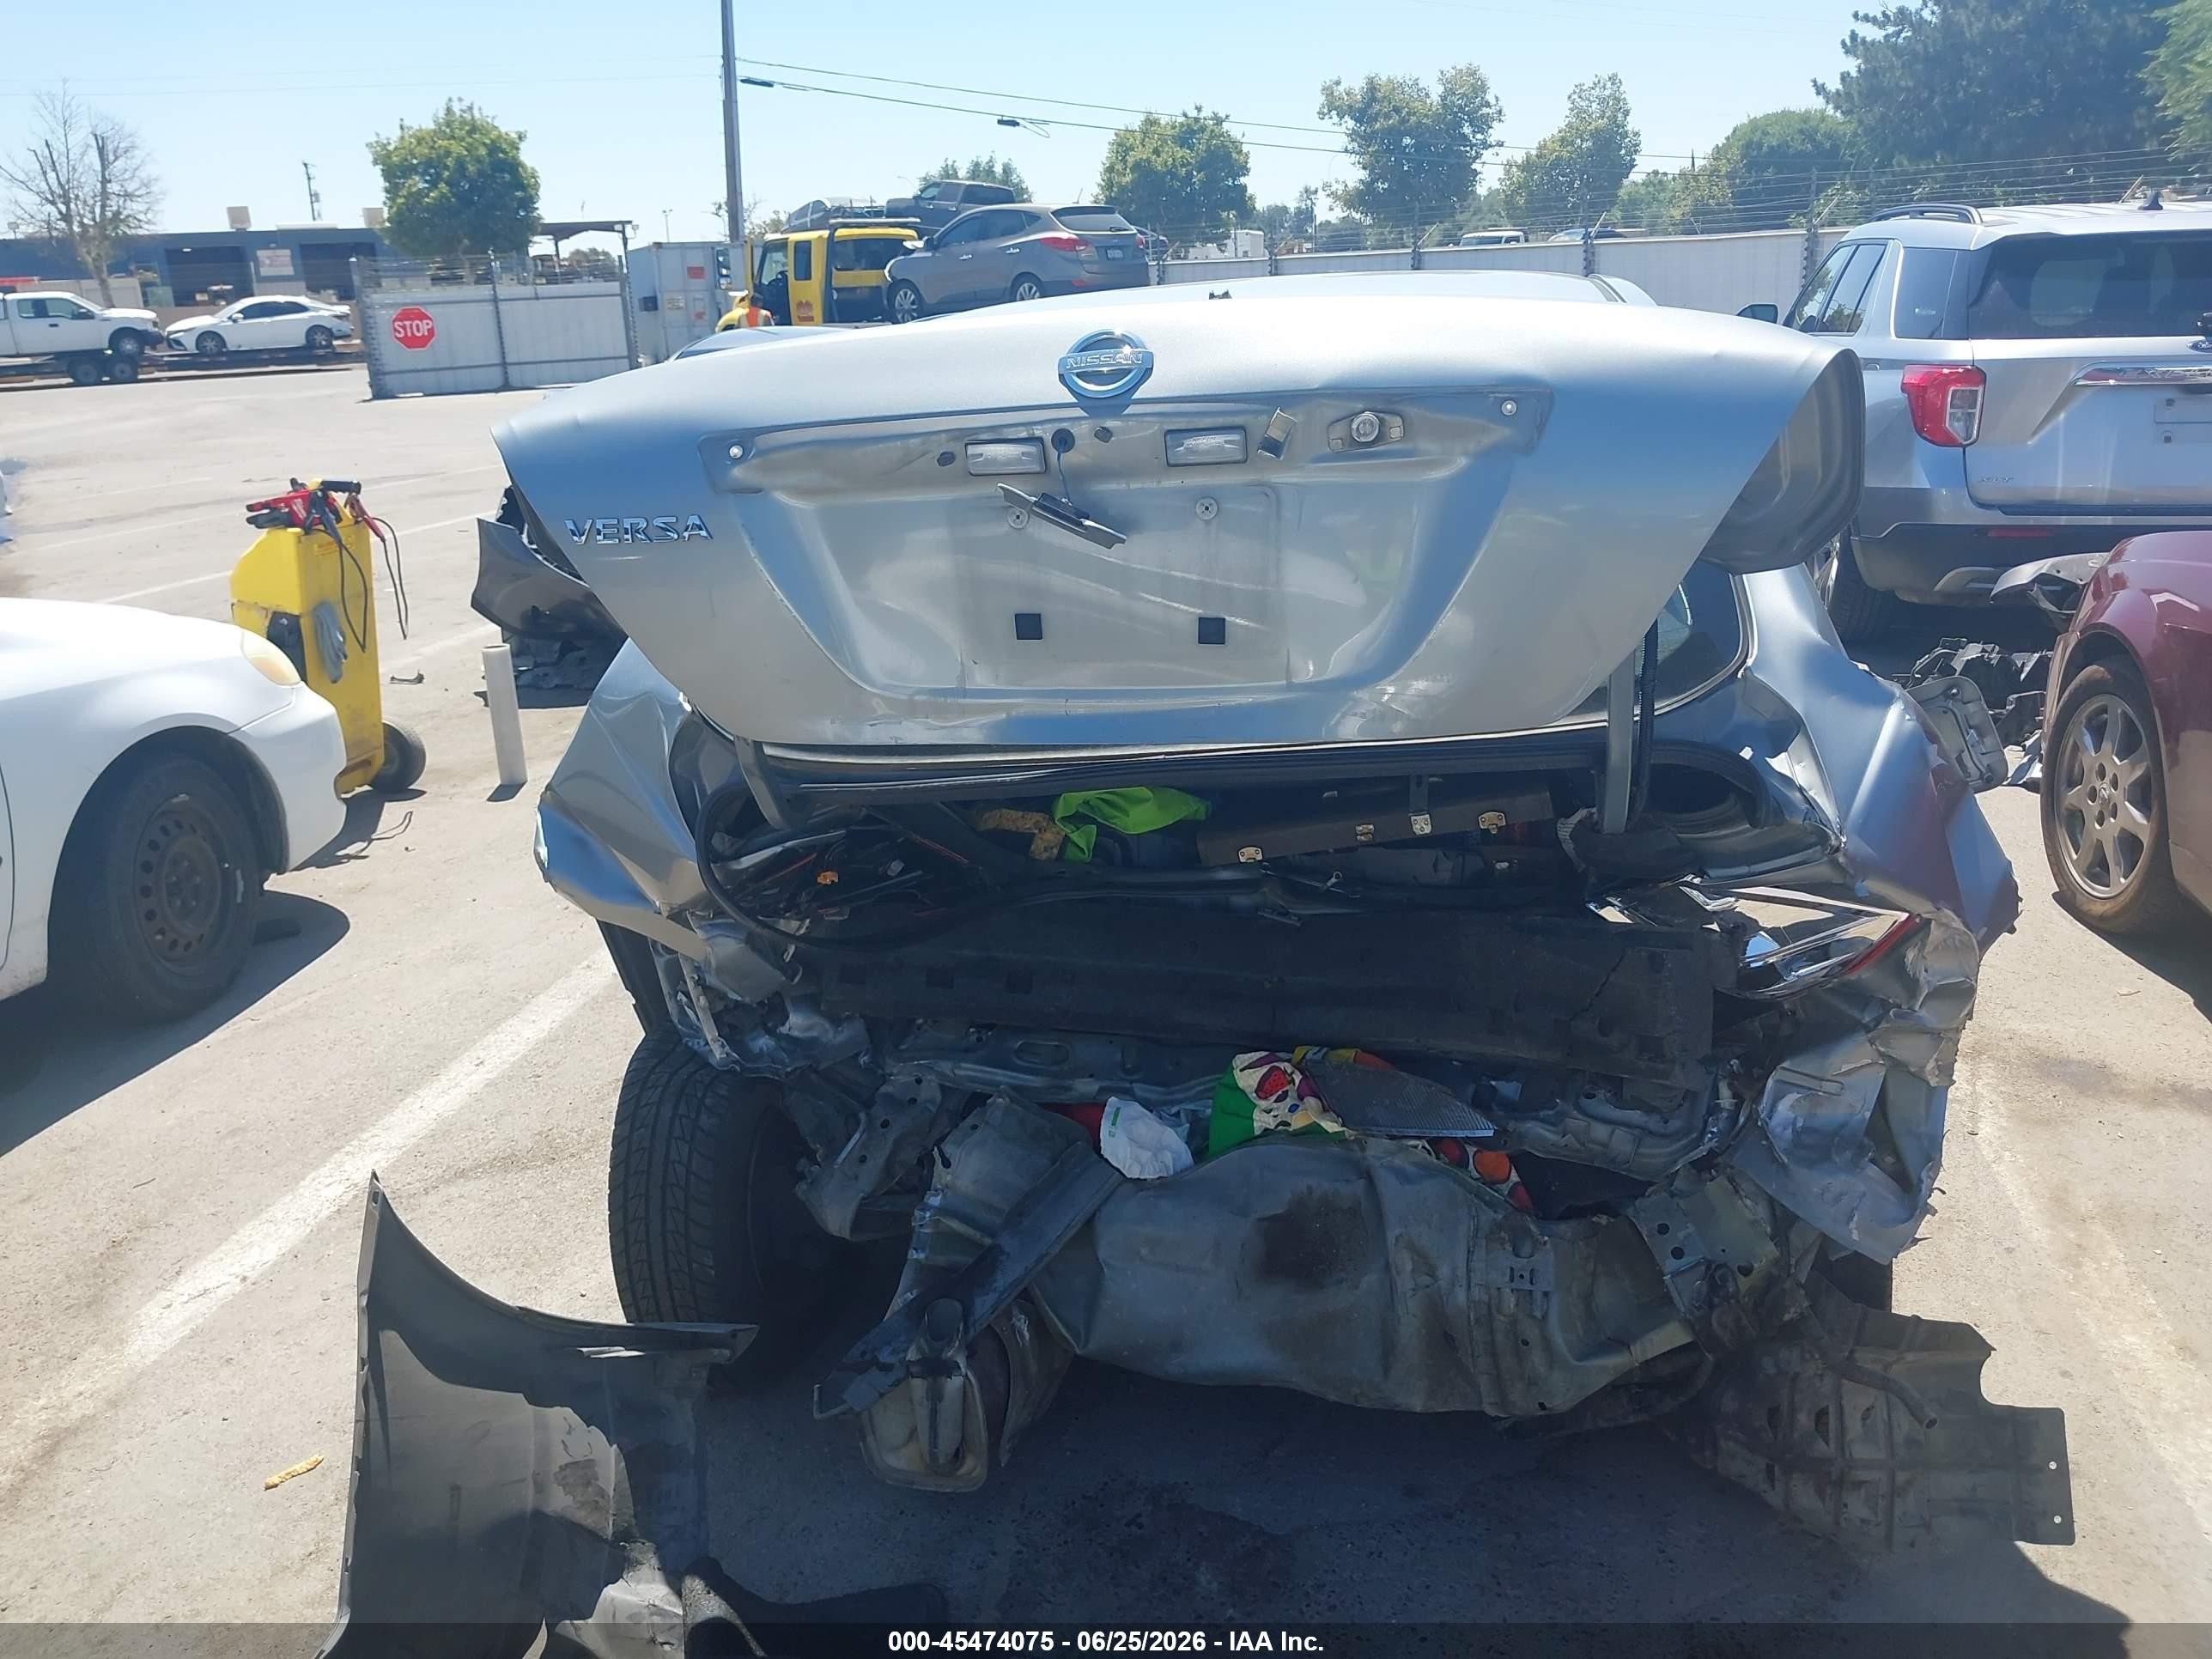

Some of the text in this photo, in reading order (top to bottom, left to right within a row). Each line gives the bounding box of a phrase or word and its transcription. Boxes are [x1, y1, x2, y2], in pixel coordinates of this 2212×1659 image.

[394, 319, 433, 338] STOP
[1066, 353, 1143, 369] NISSAN
[564, 514, 713, 544] VERSA
